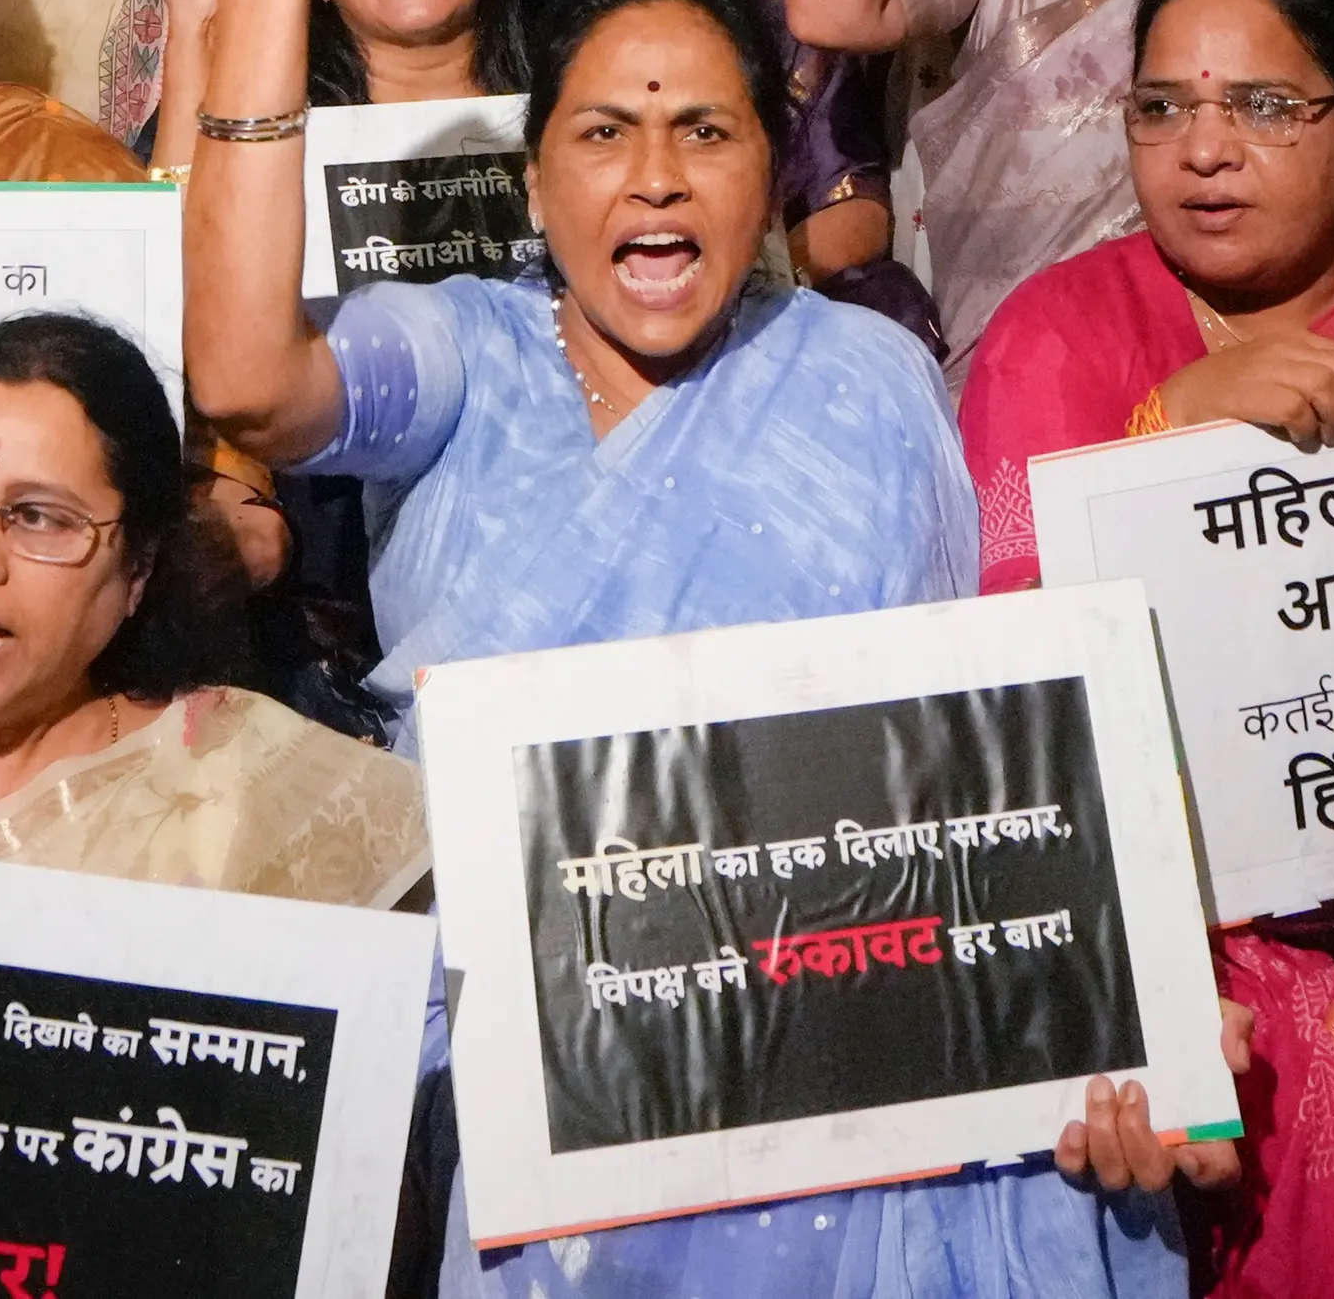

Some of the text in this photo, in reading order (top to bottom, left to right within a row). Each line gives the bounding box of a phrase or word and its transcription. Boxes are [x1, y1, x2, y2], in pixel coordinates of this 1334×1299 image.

[337, 167, 519, 207] ढोंग की राजनीति,
[2, 263, 50, 297] का
[341, 230, 476, 274] महिलाओं
[480, 236, 503, 262] के
[1239, 673, 1334, 742] कतई
[557, 804, 1072, 901] महिला का हक दिलाए सरकार,
[586, 909, 1074, 1010] विपक्ष बने रुकावट हर बार!
[3, 1001, 96, 1054] दिखावे
[102, 1025, 142, 1058] का
[146, 1016, 308, 1082] सम्मान,
[15, 1125, 65, 1165] पर
[70, 1104, 247, 1191] कांग्रेस
[249, 1155, 300, 1196] का
